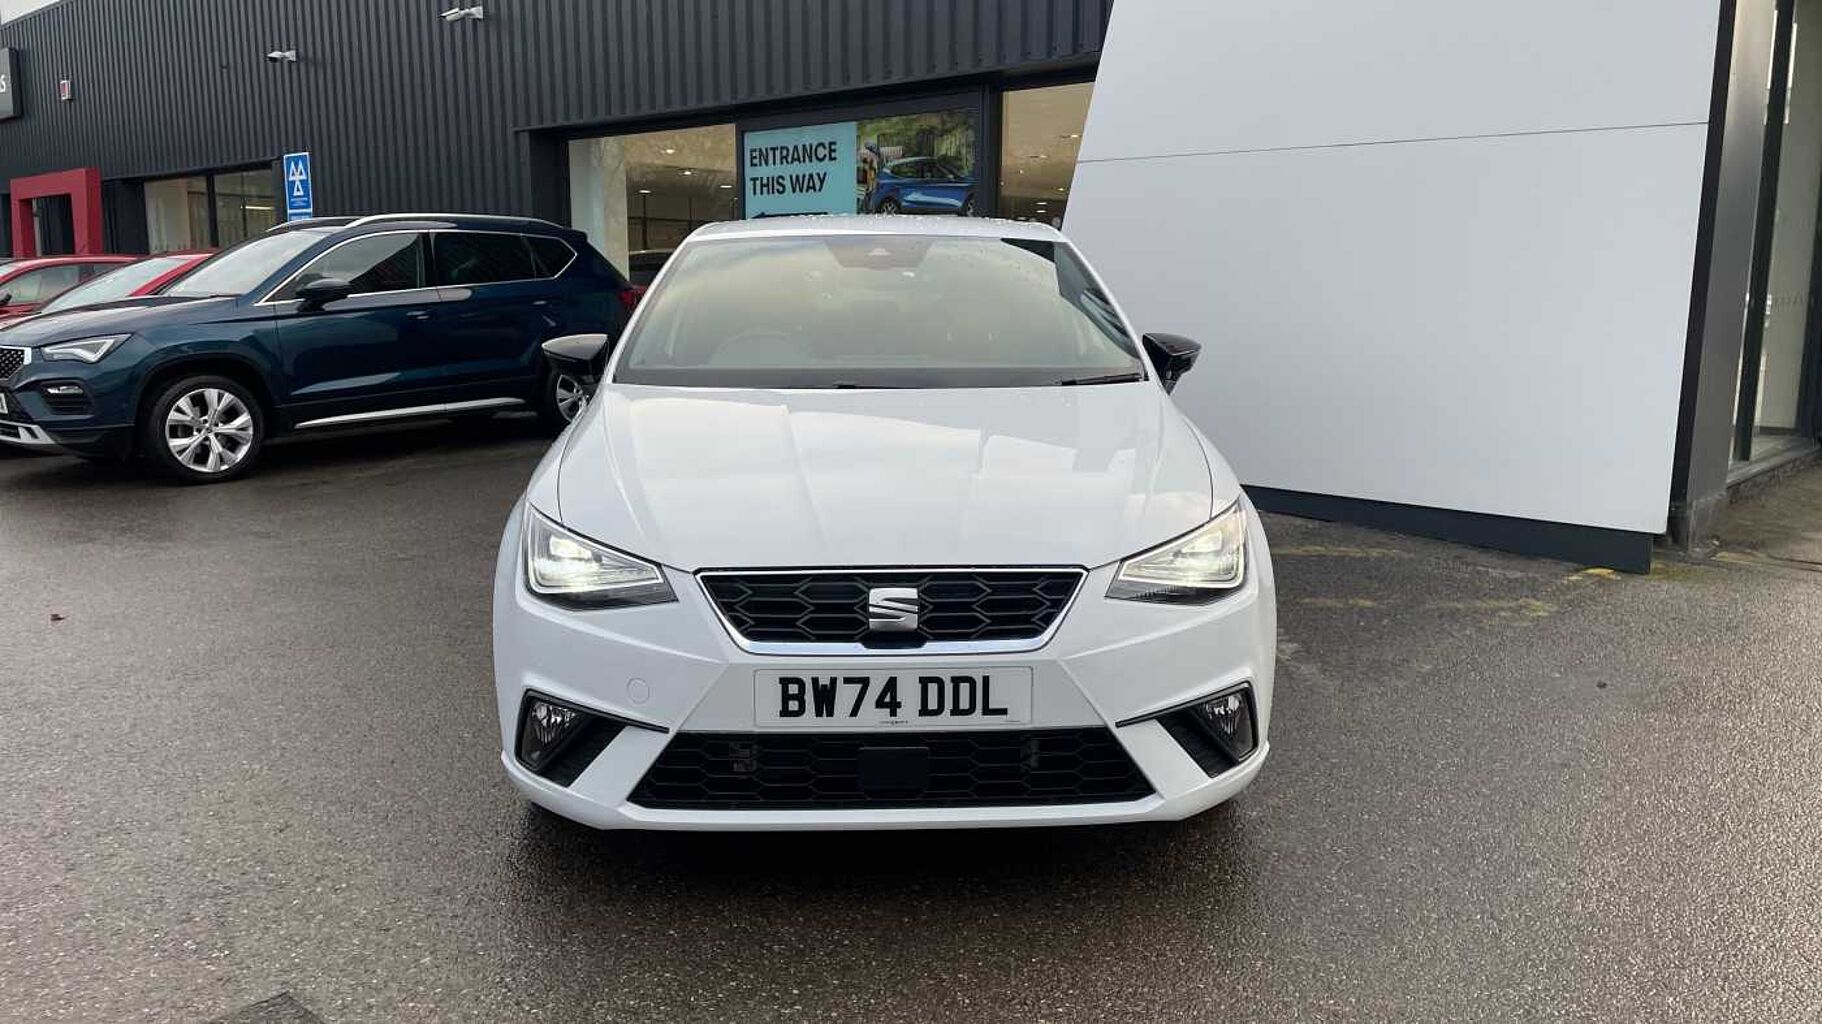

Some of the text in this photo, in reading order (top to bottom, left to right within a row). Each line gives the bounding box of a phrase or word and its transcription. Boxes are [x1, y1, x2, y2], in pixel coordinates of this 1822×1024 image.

[749, 141, 837, 167] ENTRANCE
[750, 171, 827, 196] THIS WAY
[778, 675, 1008, 718] BW74 DDL
